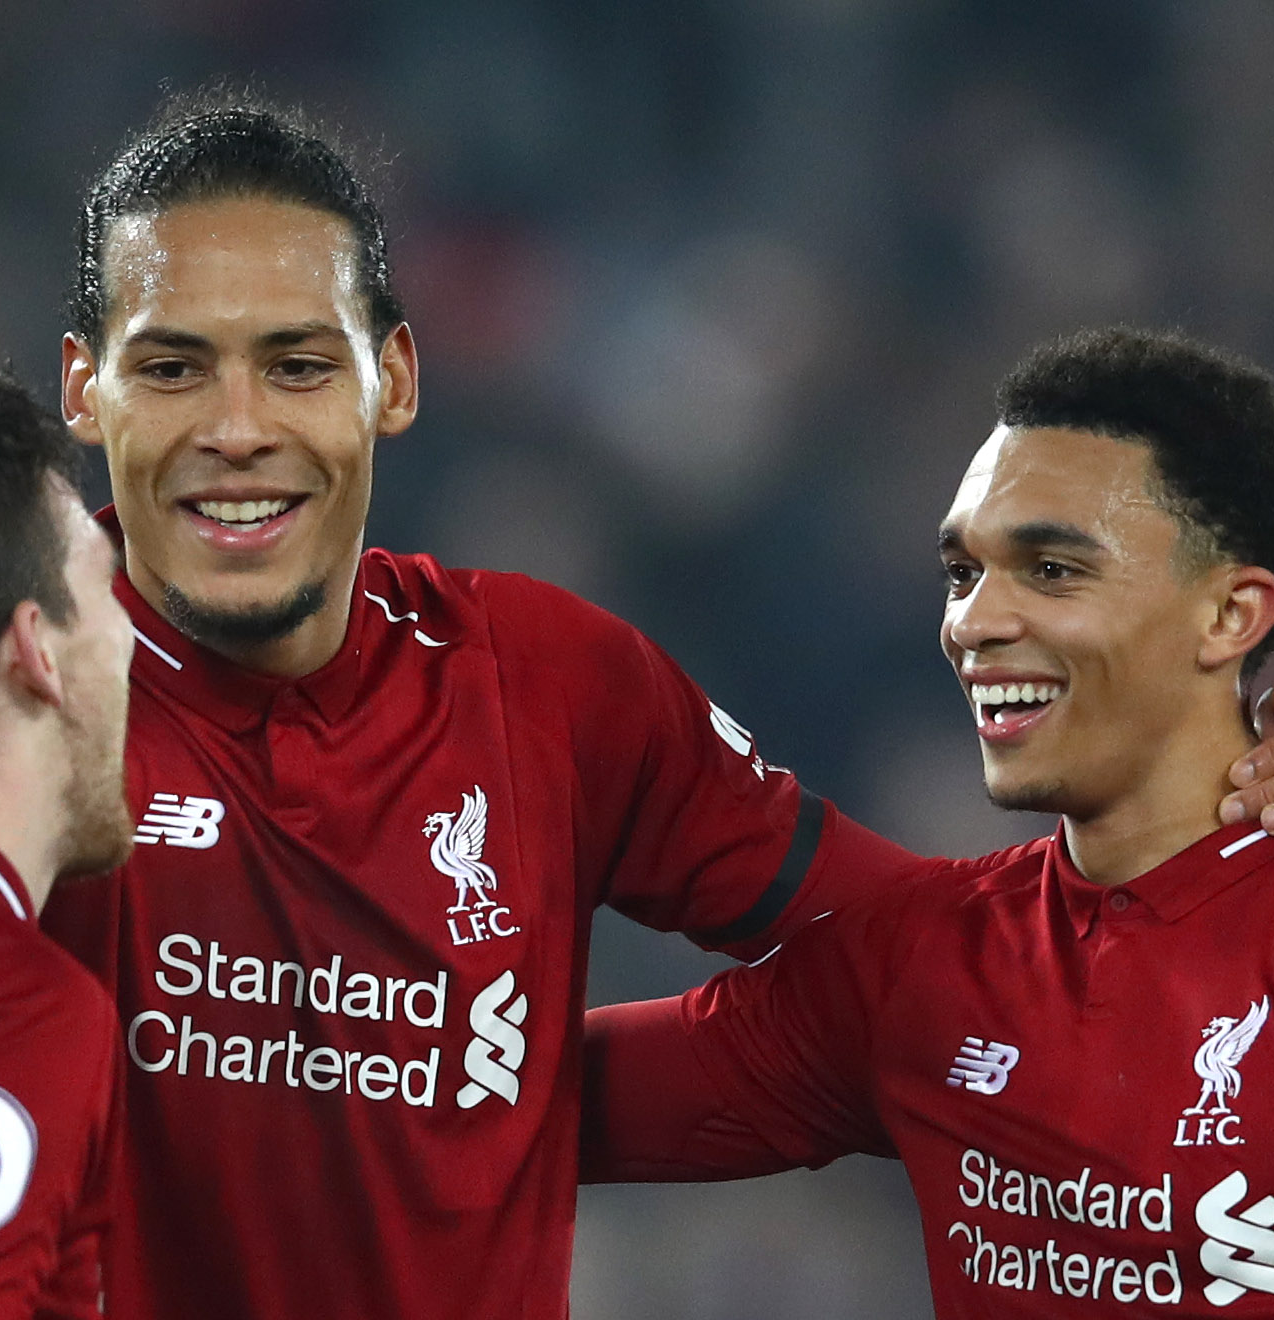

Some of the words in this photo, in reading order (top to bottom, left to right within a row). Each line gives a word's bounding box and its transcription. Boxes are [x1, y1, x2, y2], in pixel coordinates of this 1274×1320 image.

[155, 932, 447, 1030] Standard
[127, 1010, 439, 1108] Chartered
[959, 1149, 1172, 1233] Standard
